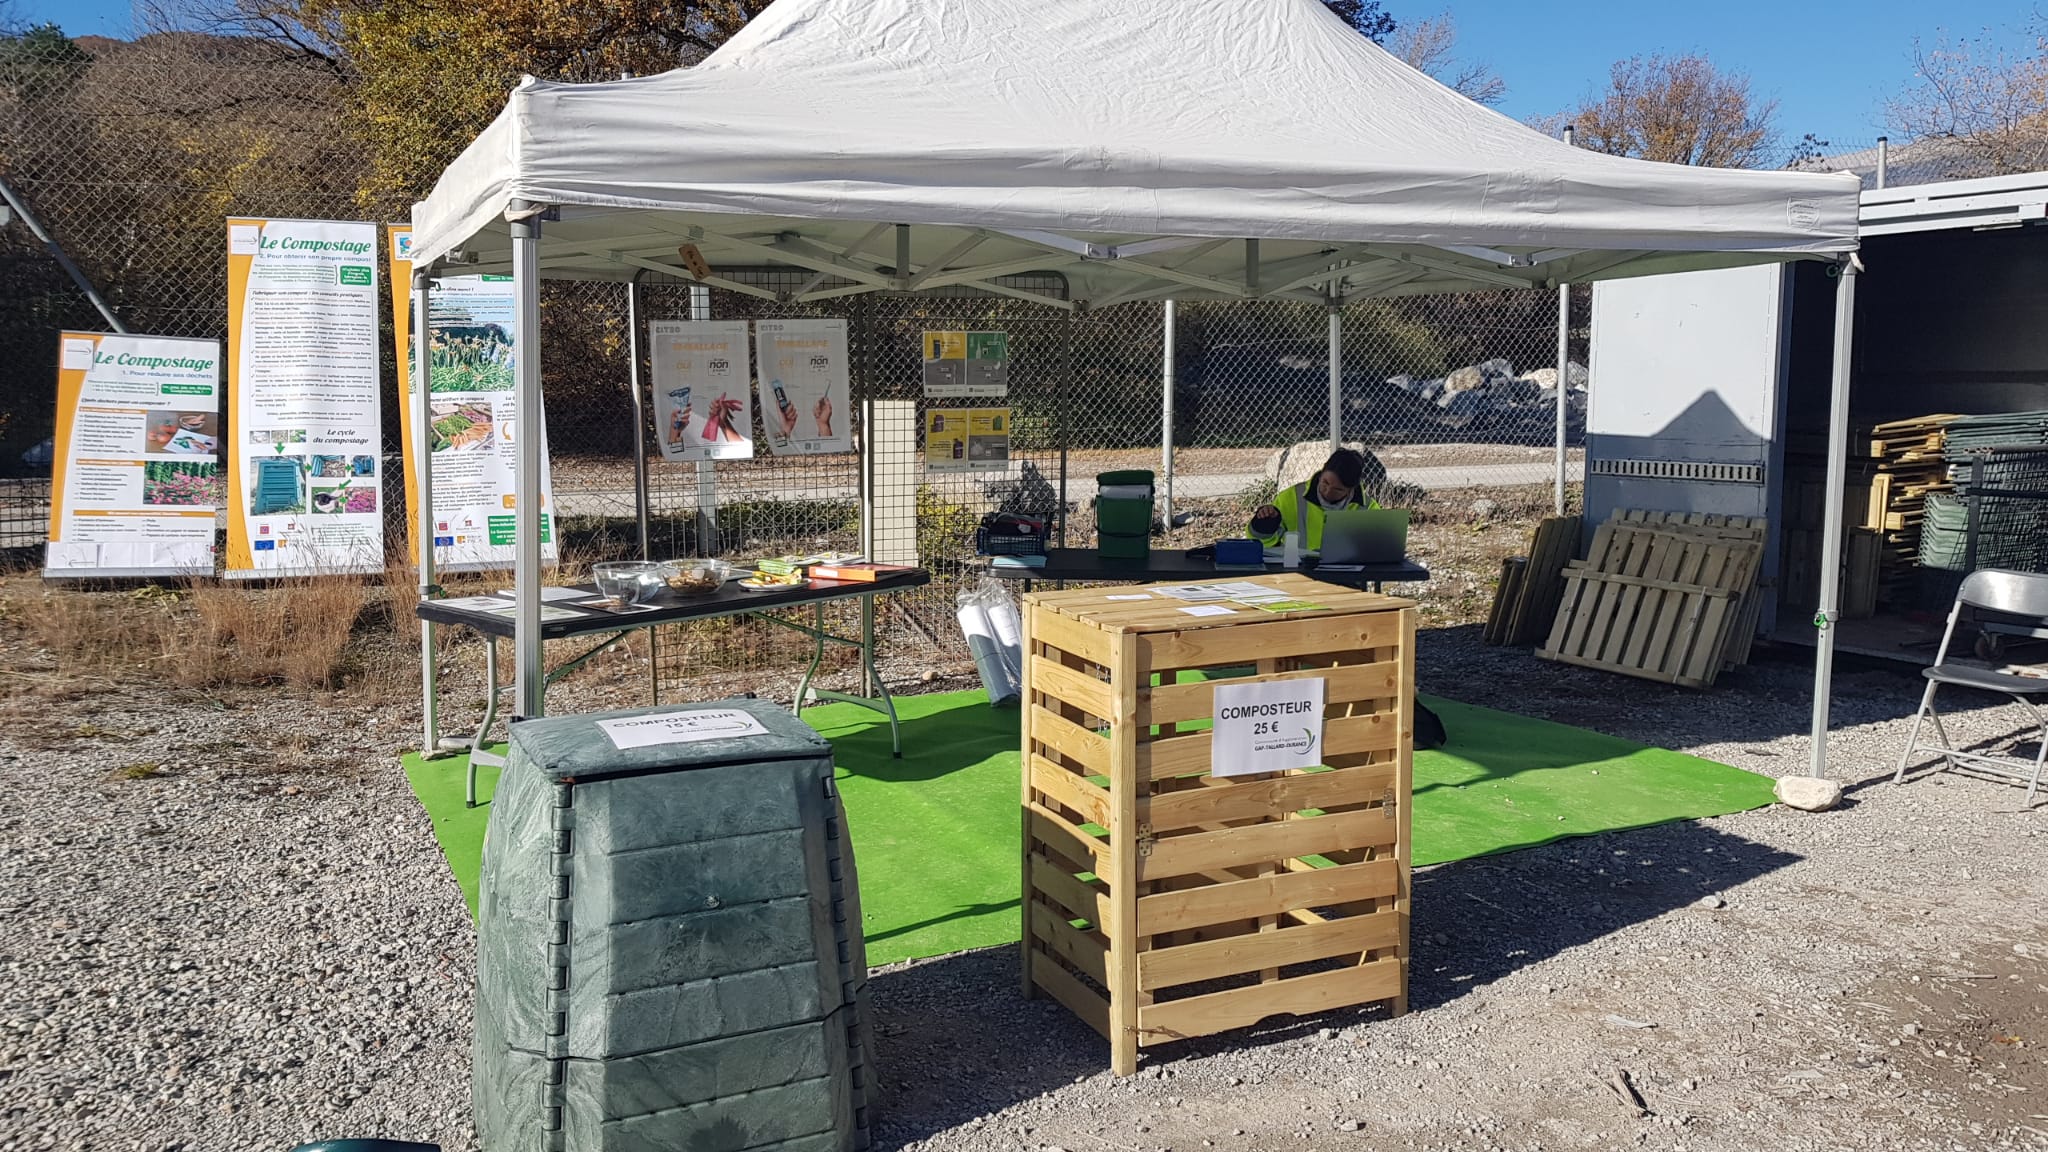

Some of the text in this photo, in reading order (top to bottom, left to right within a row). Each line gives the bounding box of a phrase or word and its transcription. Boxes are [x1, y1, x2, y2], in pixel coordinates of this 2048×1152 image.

[260, 236, 371, 255] Le Compostage
[95, 351, 213, 371] Le Compostage
[709, 361, 729, 369] non
[337, 429, 356, 437] cycle
[324, 437, 369, 445] compostage
[1221, 701, 1312, 720] COMPOSTEUR
[613, 713, 736, 727] COMPOSTEUR
[1254, 721, 1279, 735] 25 €
